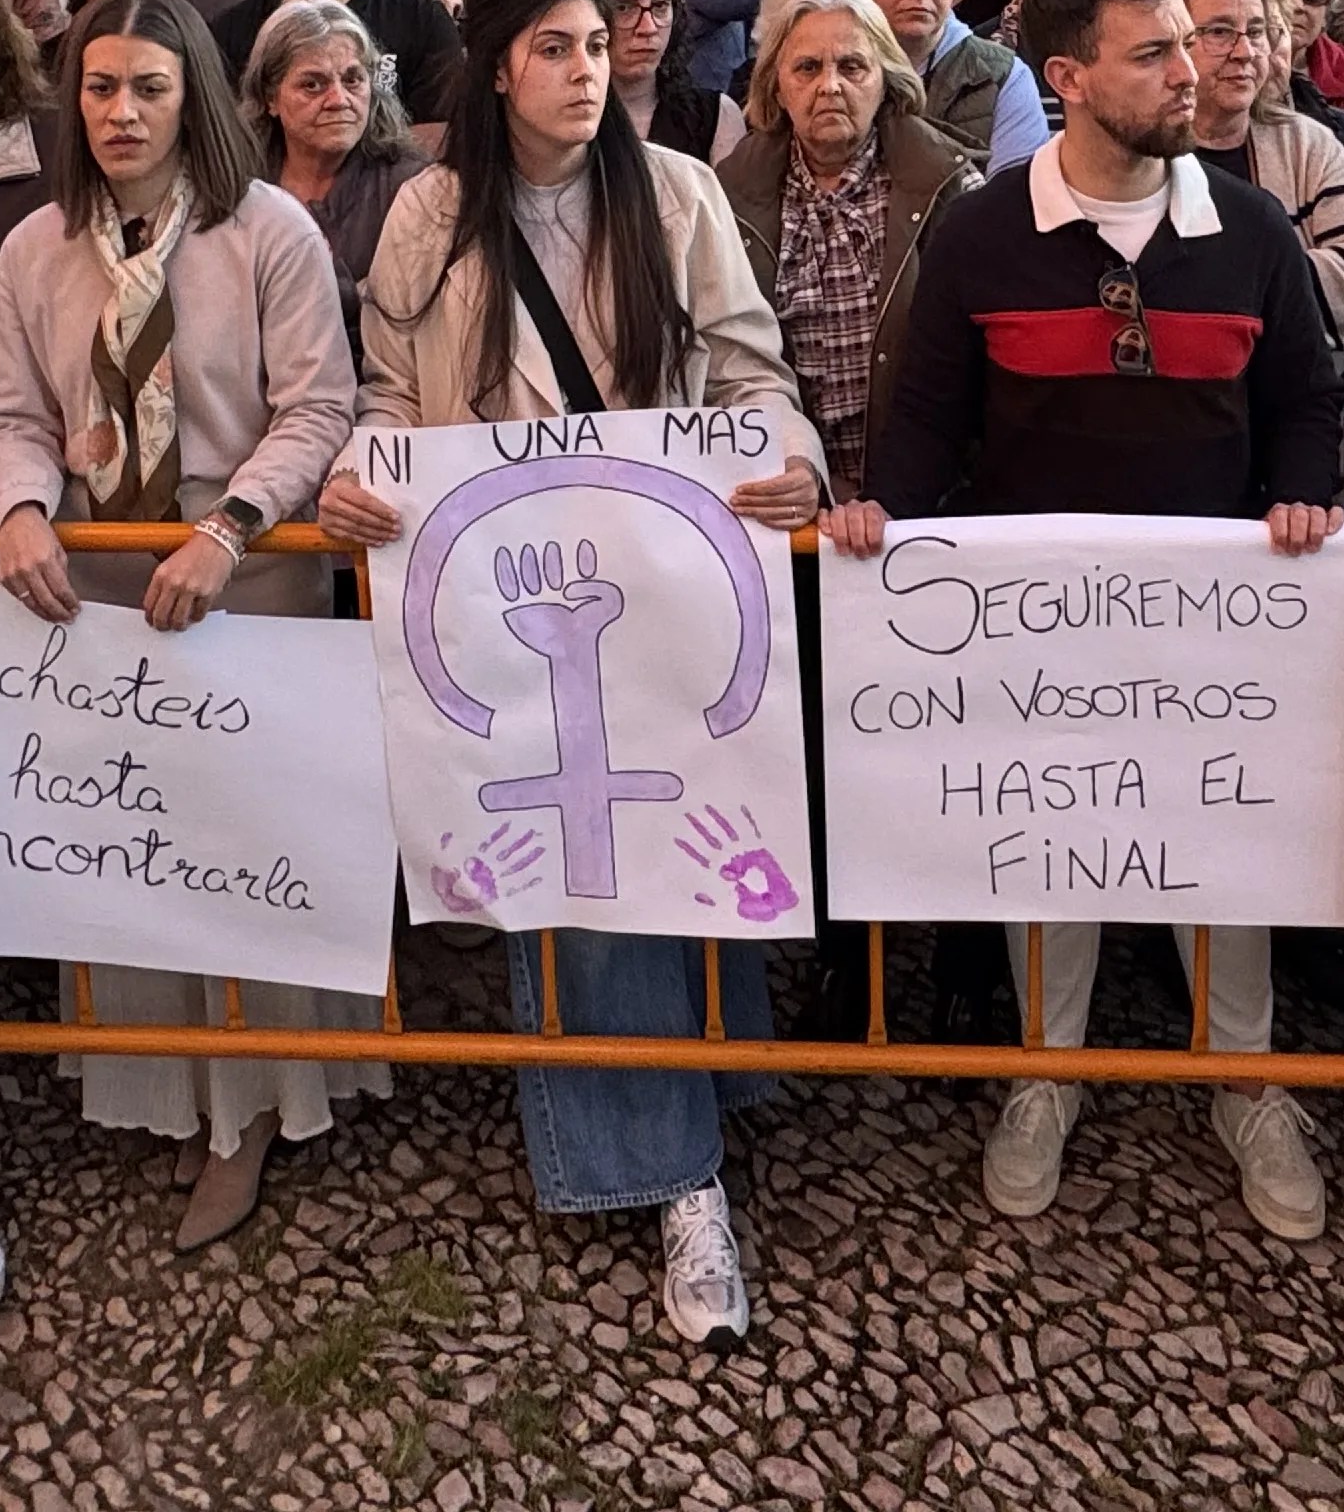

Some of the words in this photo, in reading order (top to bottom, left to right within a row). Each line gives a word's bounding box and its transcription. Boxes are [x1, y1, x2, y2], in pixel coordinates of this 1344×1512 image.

[368, 434, 413, 486] NI
[492, 414, 604, 463] UNA
[850, 675, 965, 734] CON
[999, 668, 1278, 723] VOSOTROS
[8, 732, 168, 814] hasta
[940, 758, 1147, 817] HASTA
[1200, 751, 1276, 806] EL
